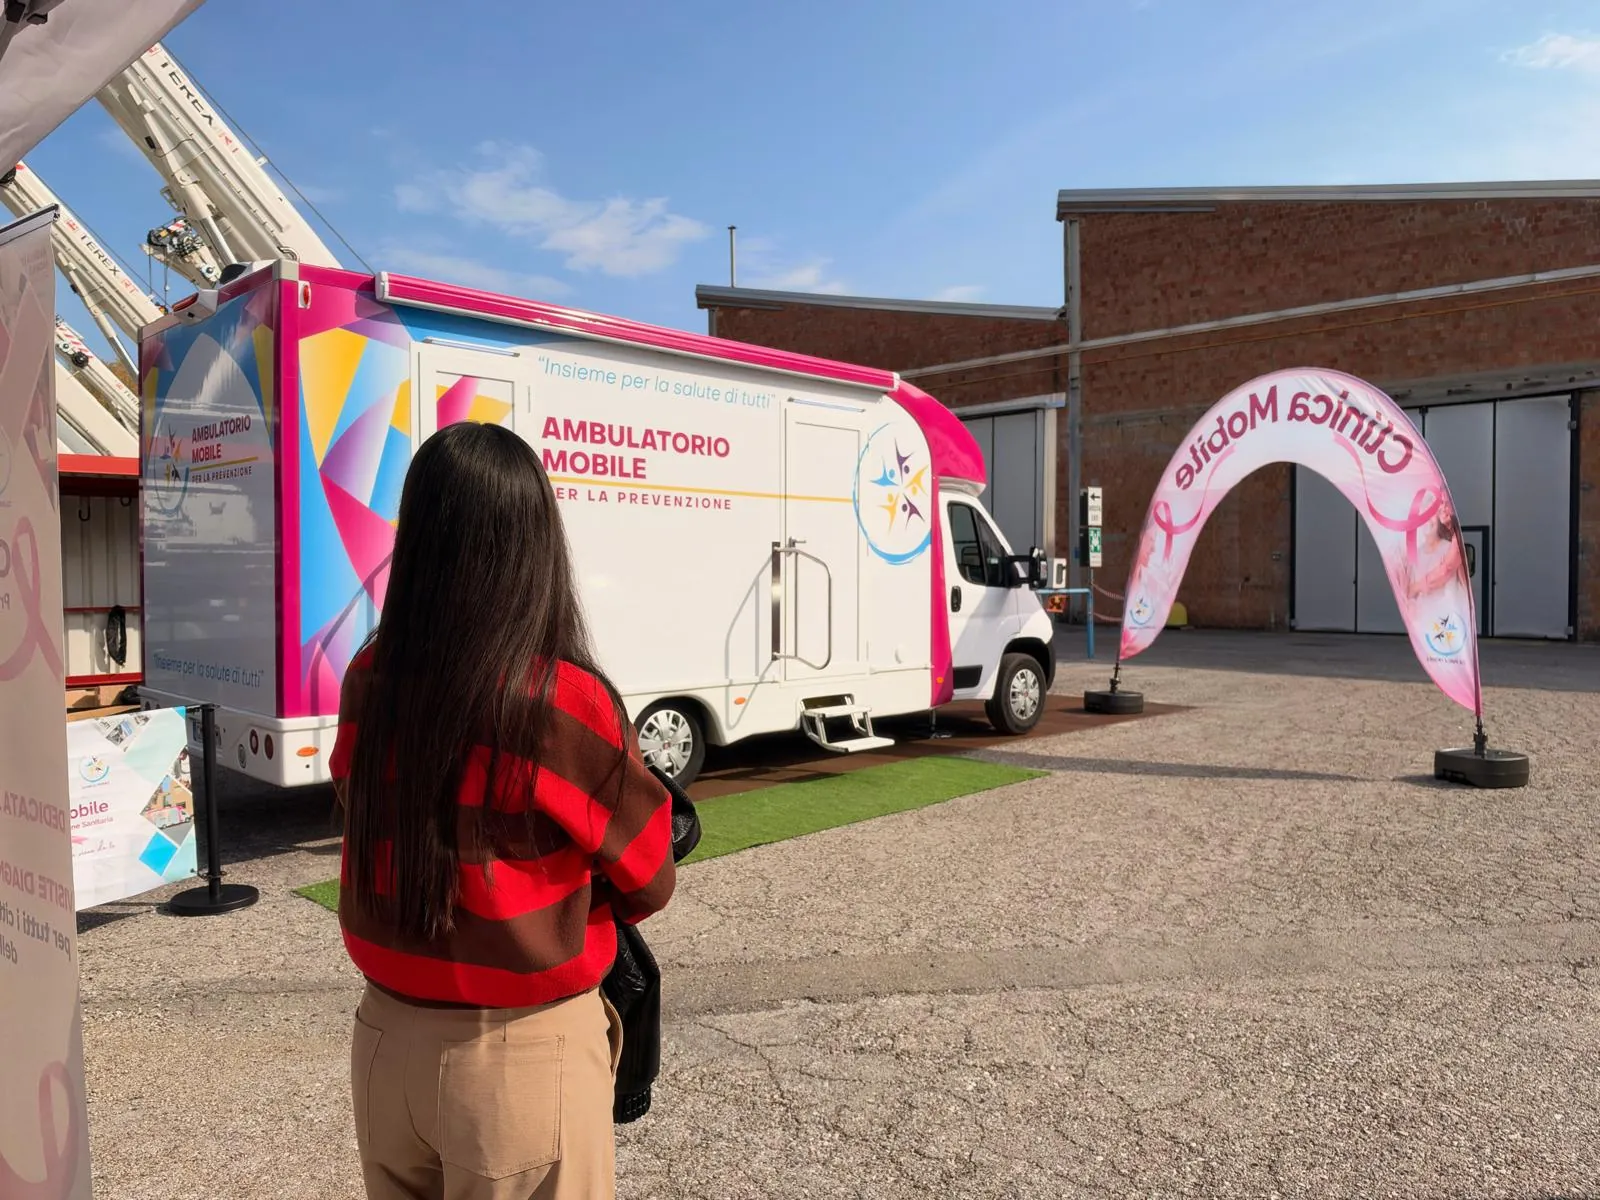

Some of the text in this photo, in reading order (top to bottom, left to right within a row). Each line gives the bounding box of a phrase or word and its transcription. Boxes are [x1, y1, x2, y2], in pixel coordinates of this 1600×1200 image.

[81, 233, 120, 277] TEREX
[621, 375, 650, 390] per
[655, 376, 669, 392] la
[674, 382, 720, 401] salute
[725, 388, 738, 404] di
[192, 415, 251, 444] AMBULATORIO
[541, 416, 730, 458] AMBULATORIO
[192, 444, 221, 464] MOBILE
[543, 448, 647, 479] MOBILE
[211, 466, 252, 480] PREVENZIONE
[556, 487, 732, 510] ER LA PREVENZIONE
[183, 659, 196, 679] per
[206, 663, 230, 683] salute
[70, 801, 108, 819] obile
